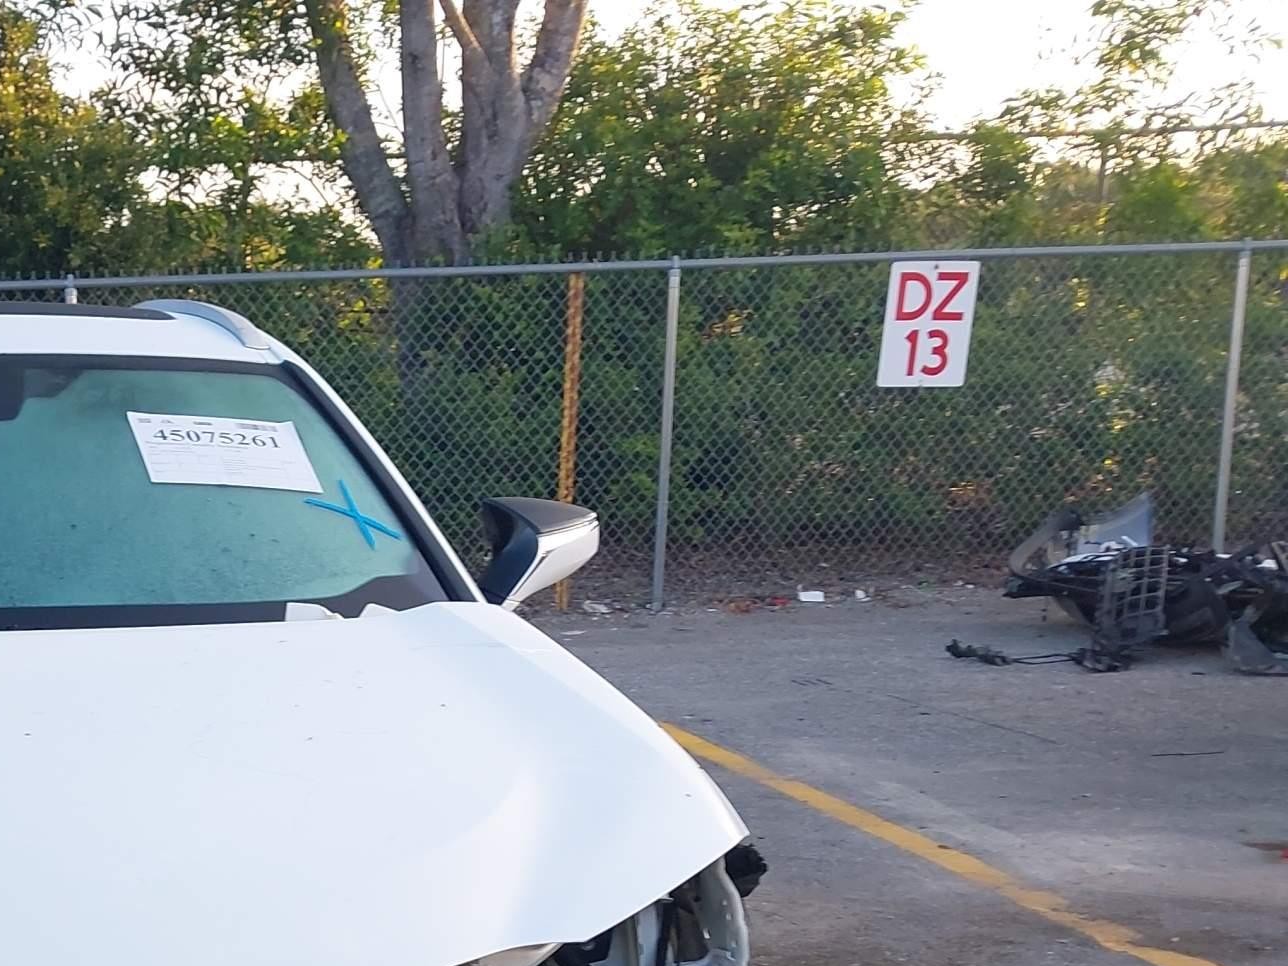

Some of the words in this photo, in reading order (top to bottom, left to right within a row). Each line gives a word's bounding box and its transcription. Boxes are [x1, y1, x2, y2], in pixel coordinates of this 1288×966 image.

[895, 271, 970, 321] DZ
[904, 329, 950, 377] 13
[152, 428, 281, 449] 45075261
